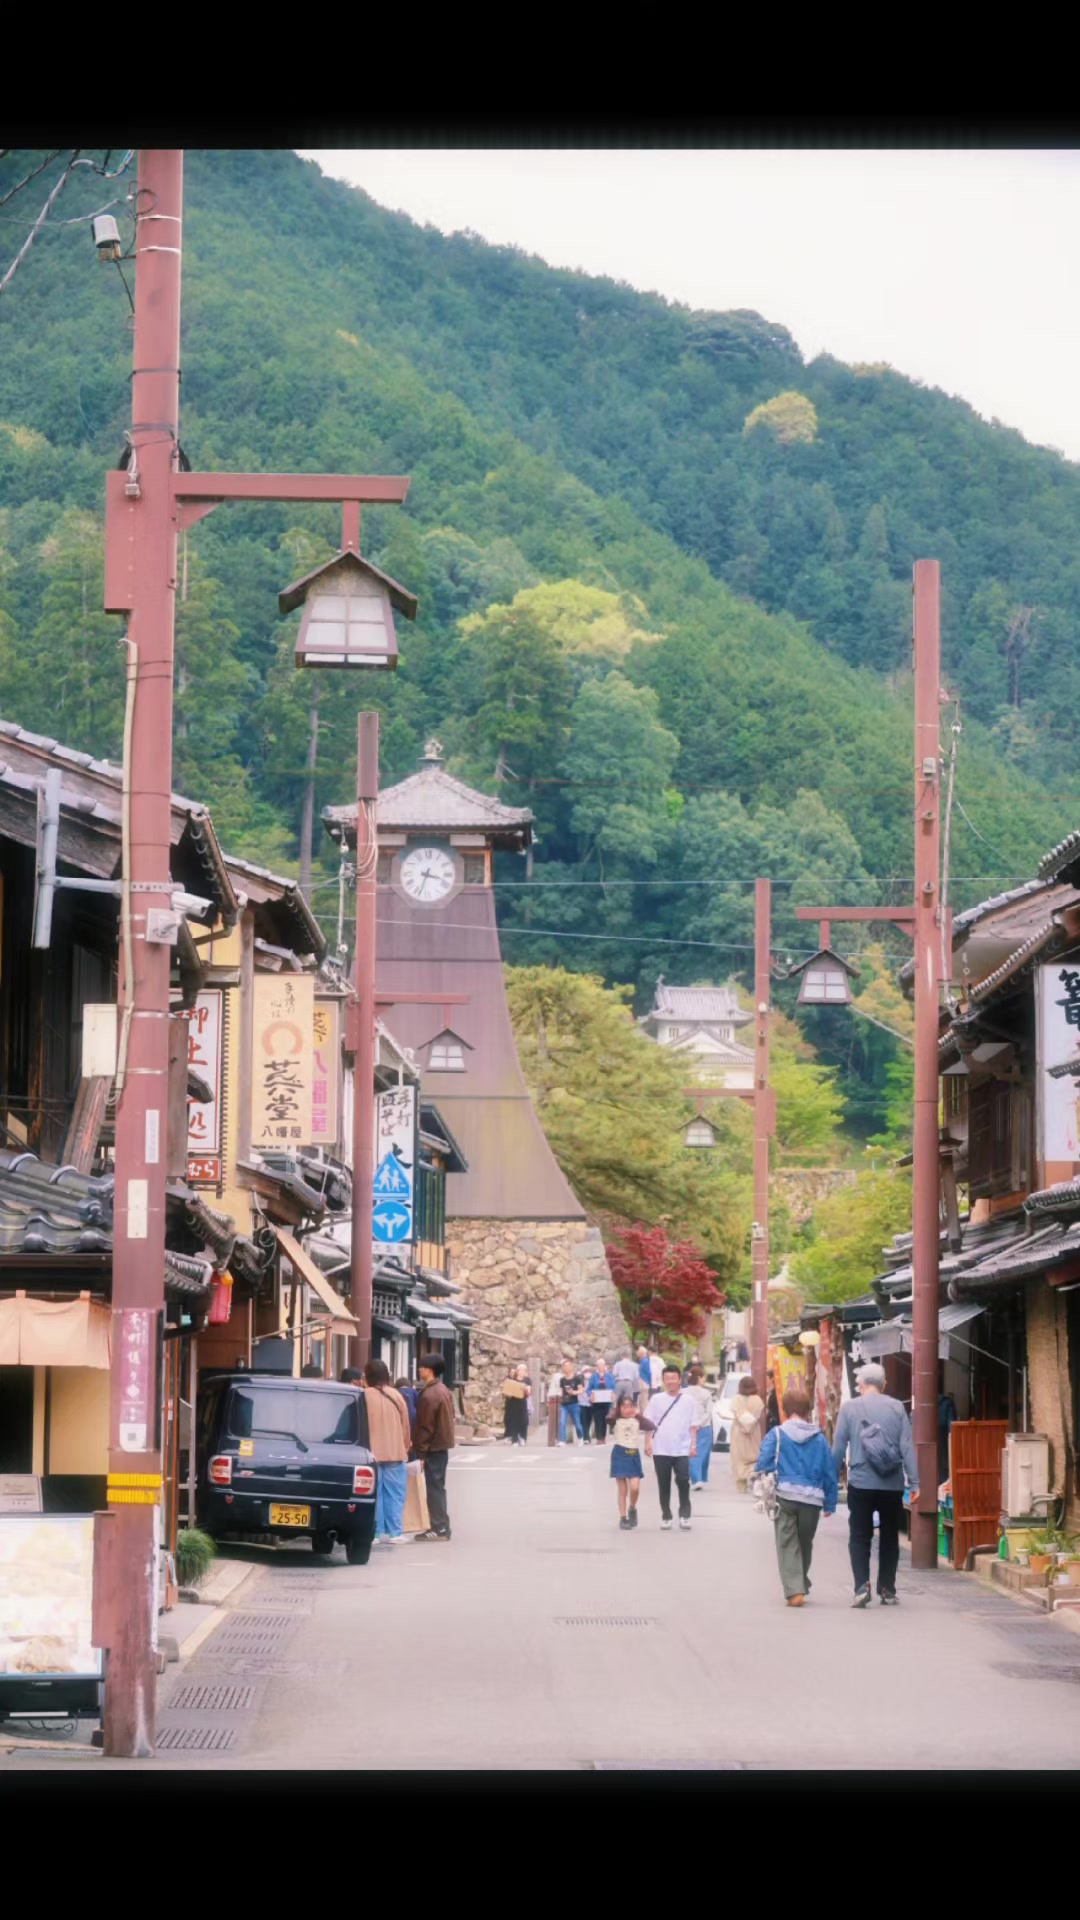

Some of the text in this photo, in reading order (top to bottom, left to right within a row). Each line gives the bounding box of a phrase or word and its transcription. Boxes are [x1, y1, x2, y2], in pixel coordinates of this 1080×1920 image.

[261, 1125, 302, 1138] 八幡屋
[277, 1512, 308, 1525] 25-50
